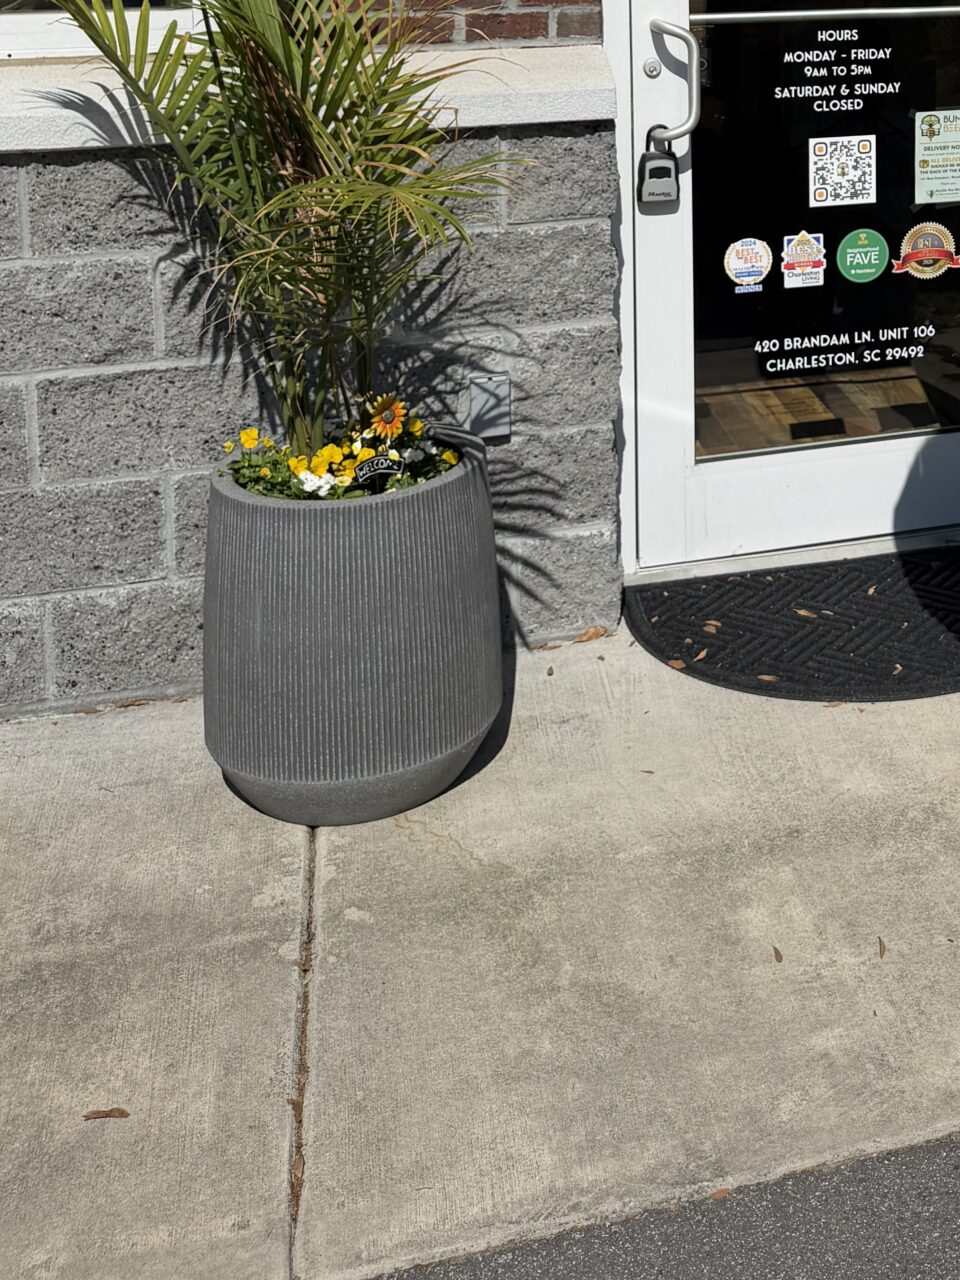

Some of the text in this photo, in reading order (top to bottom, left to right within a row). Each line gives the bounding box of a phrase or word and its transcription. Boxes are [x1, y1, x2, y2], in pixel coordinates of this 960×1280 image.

[817, 29, 859, 42] HOURS
[783, 50, 837, 63] MONDAY
[851, 48, 892, 60] FRIDAY
[804, 64, 872, 78] 9AM TO 5PM
[774, 82, 901, 99] SATURDAY & SUNDAY
[813, 99, 864, 112] CLOSED
[740, 239, 757, 247] 2024
[735, 248, 755, 258] BEST
[743, 255, 763, 264] BEST
[846, 251, 880, 266] FAVE
[754, 324, 936, 353] 420 BRANDAM LN. UNIT 106
[863, 349, 881, 362] SC
[886, 345, 925, 361] 29492
